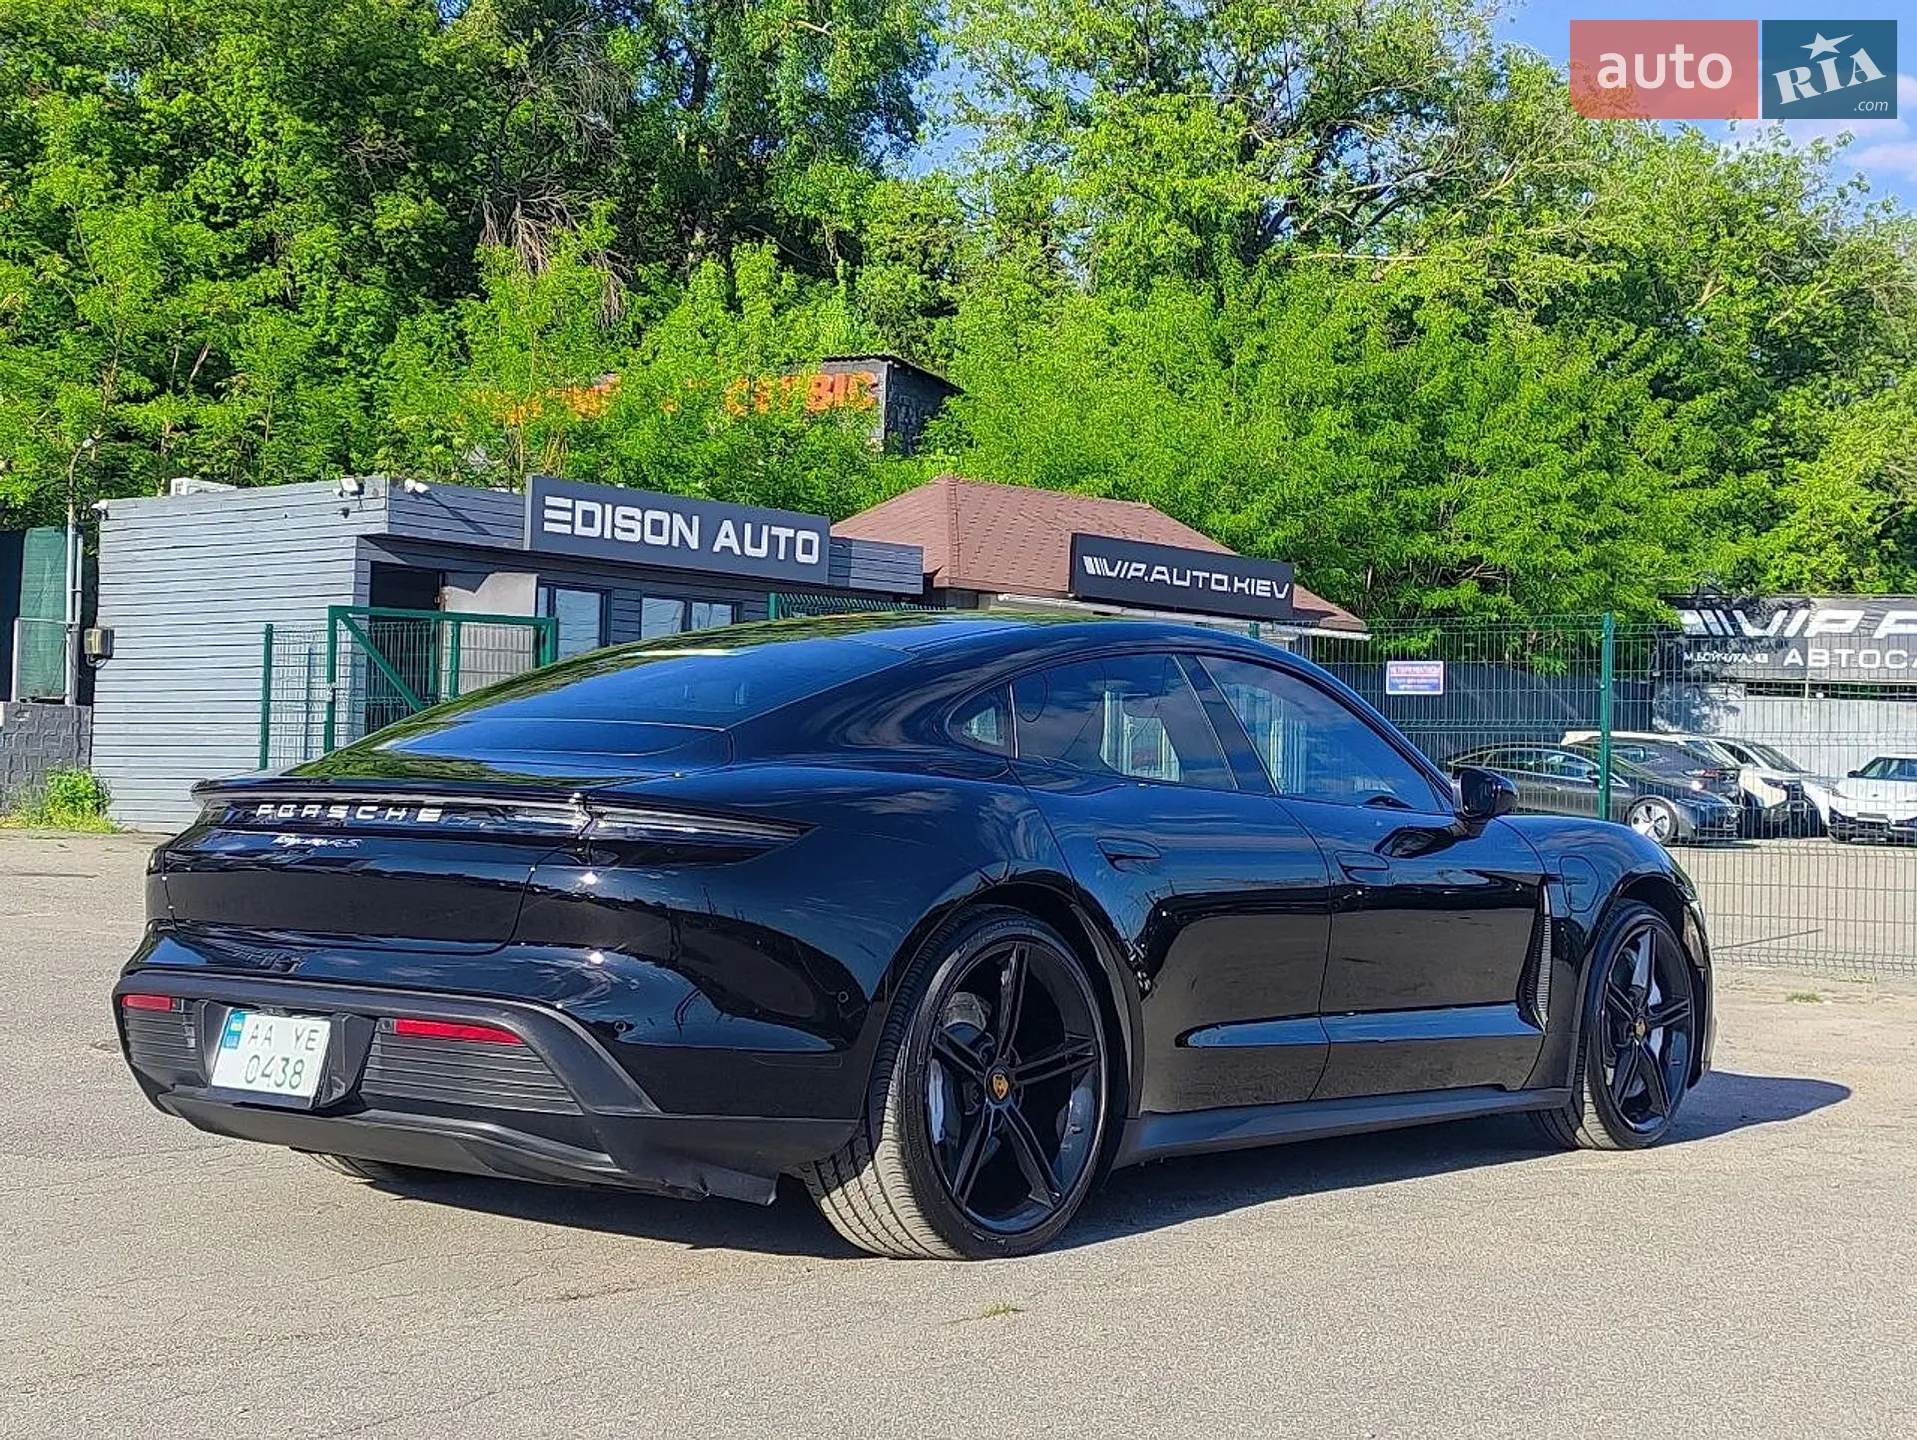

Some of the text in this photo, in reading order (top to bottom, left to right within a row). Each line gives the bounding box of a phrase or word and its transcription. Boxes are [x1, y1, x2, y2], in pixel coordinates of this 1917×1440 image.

[544, 495, 820, 565] EDISON AUTO
[255, 804, 443, 823] PORSCHE
[248, 1023, 320, 1051] AA YE
[244, 1054, 305, 1090] 0438
